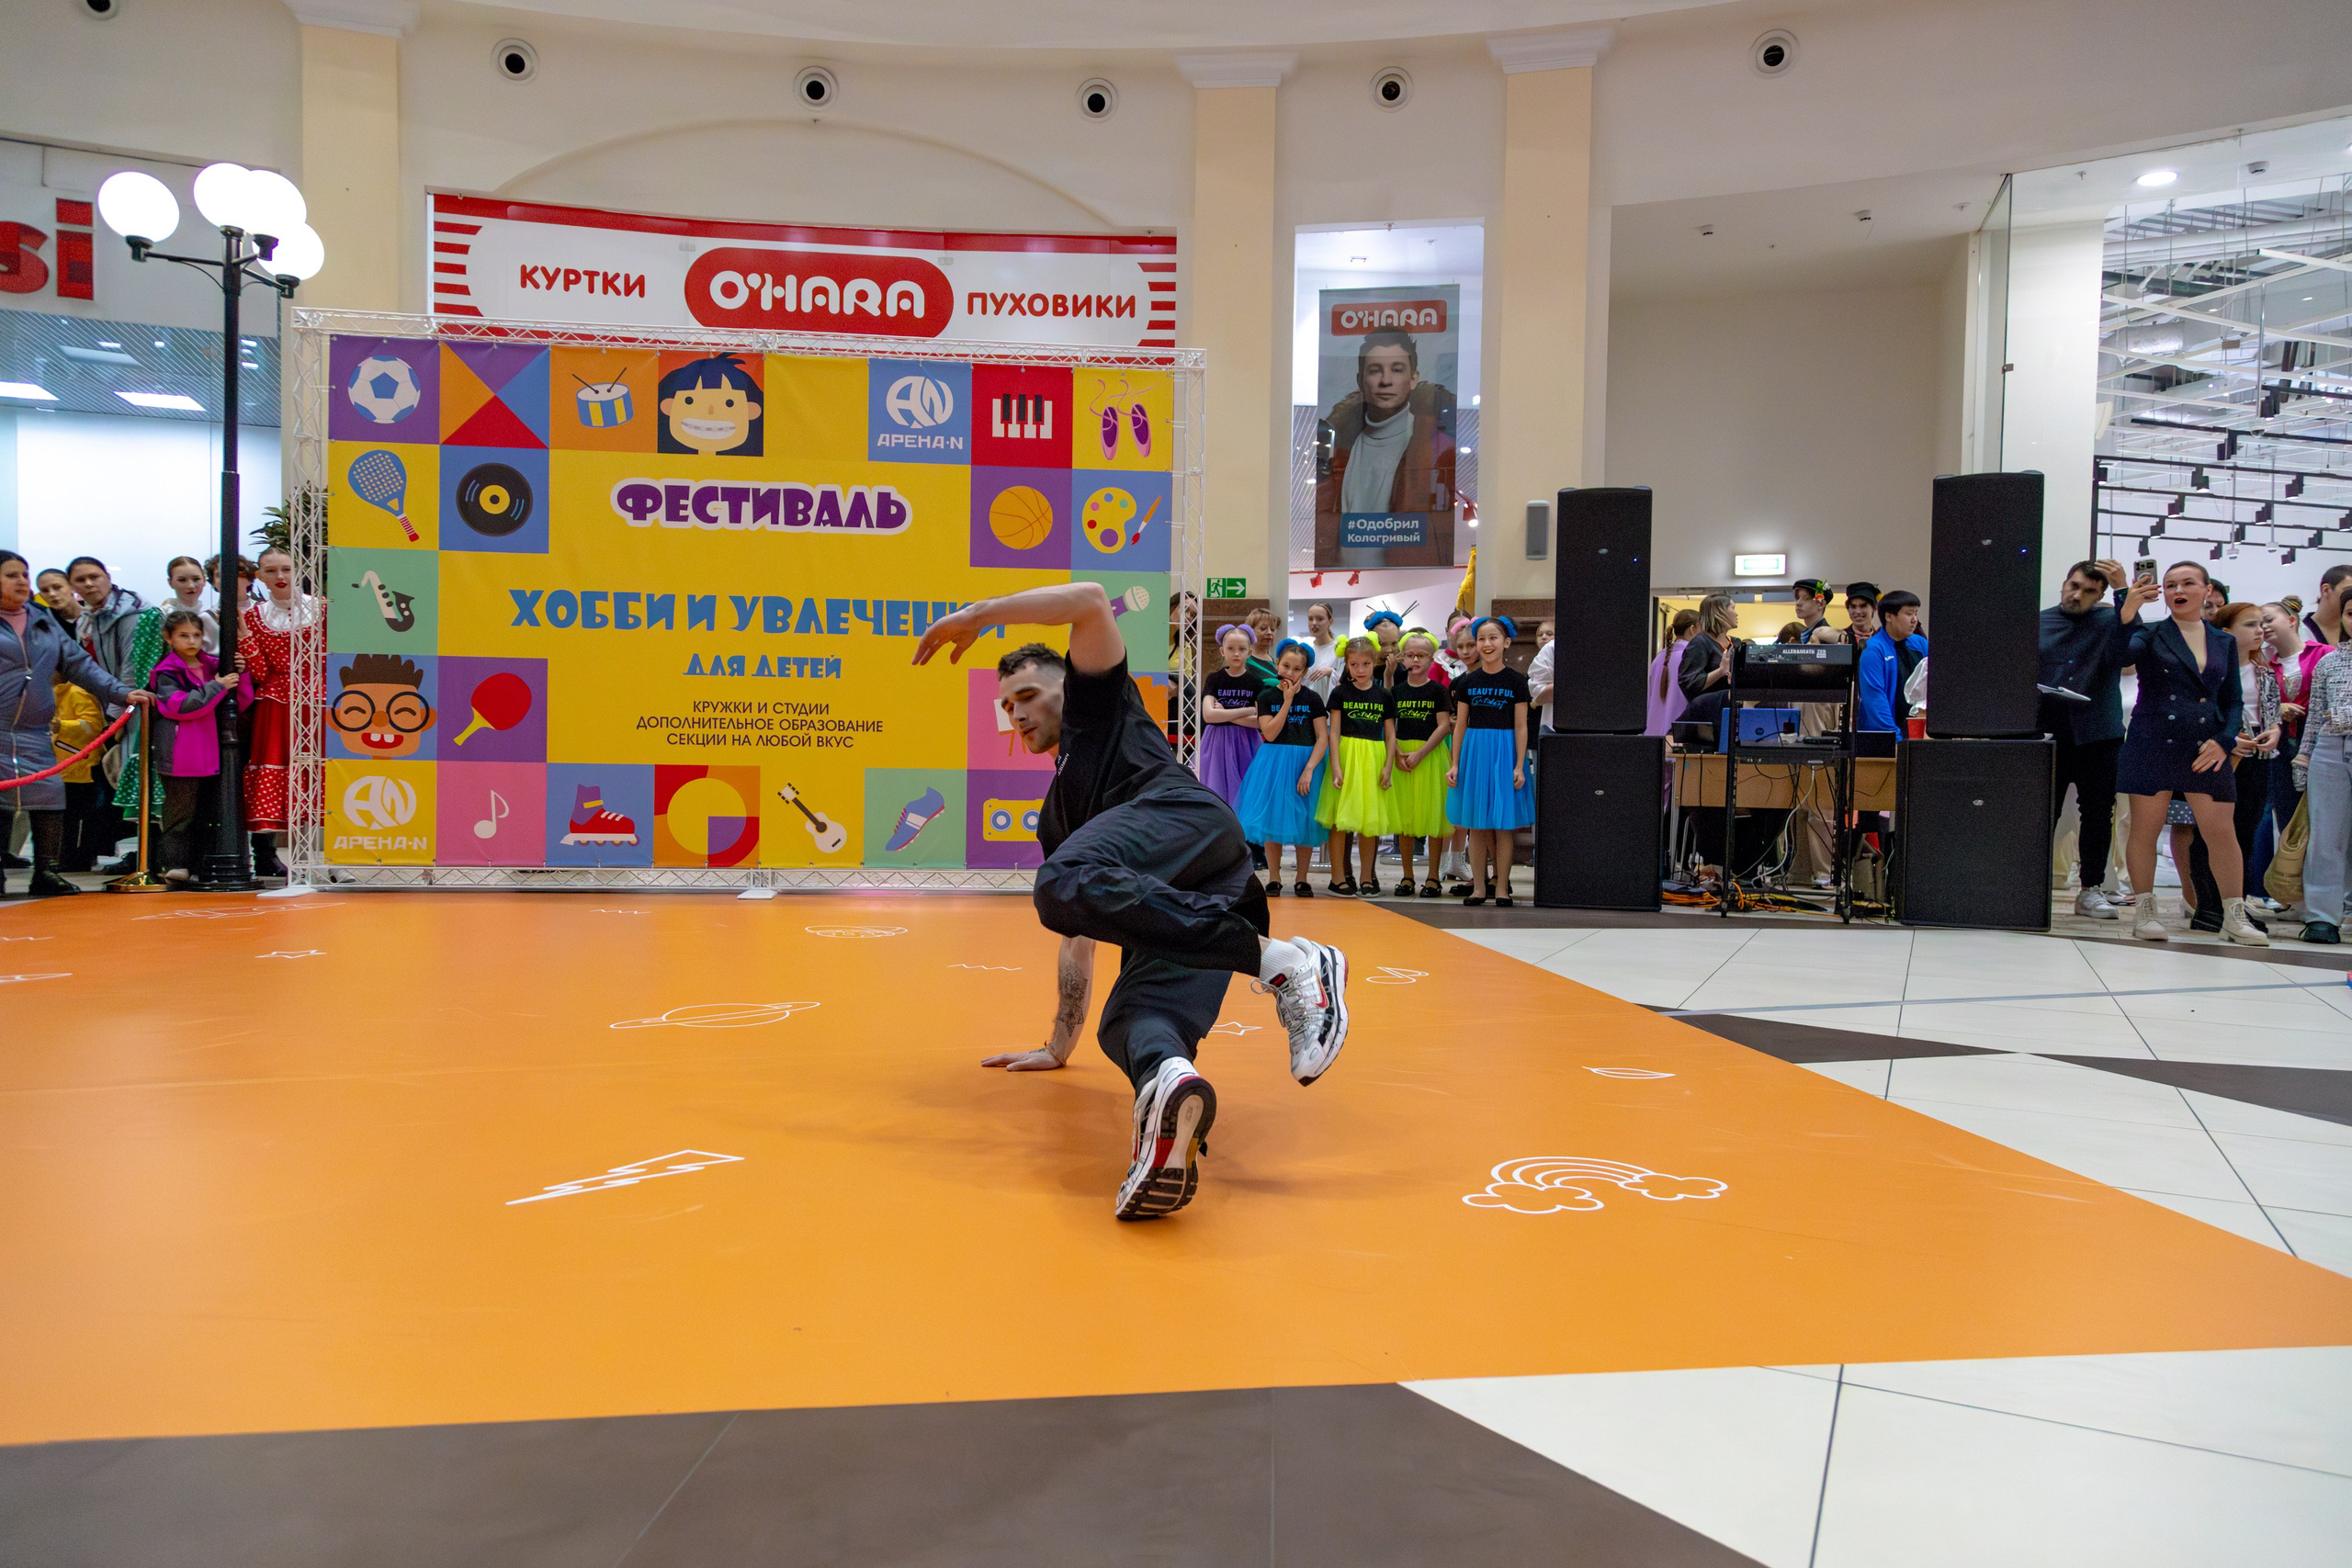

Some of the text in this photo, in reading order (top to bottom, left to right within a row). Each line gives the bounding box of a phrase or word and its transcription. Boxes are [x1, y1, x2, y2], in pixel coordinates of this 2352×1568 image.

[520, 264, 646, 299] КУРТКИ
[709, 269, 925, 318] O'HARA
[967, 291, 1136, 319] ПУХОВИКИ
[1340, 308, 1438, 329] O'HARA
[616, 483, 907, 529] ФЕСТИВАЛЬ
[1348, 518, 1419, 531] #Одобрил
[1348, 532, 1420, 544] Кологривый
[508, 589, 1005, 638] ХОББИ И УВЛЕЧЕН
[683, 653, 842, 679] ДЛЯ ДЕТЕЙ
[1217, 689, 1253, 697] EAUTIFU
[1467, 687, 1514, 698] BEAUTIFUL
[693, 701, 830, 716] КРУЖКИ И СТУДИИ
[1271, 705, 1311, 713] BETIFUL
[1342, 701, 1384, 711] BEAUTIFU
[636, 716, 884, 733] ДОПОЛНИТЕЛЬНОЕ ОБРАЗОВАНИЕ
[667, 732, 854, 749] СЕКЦИИ НА ЛЮБОЙ ВКУС
